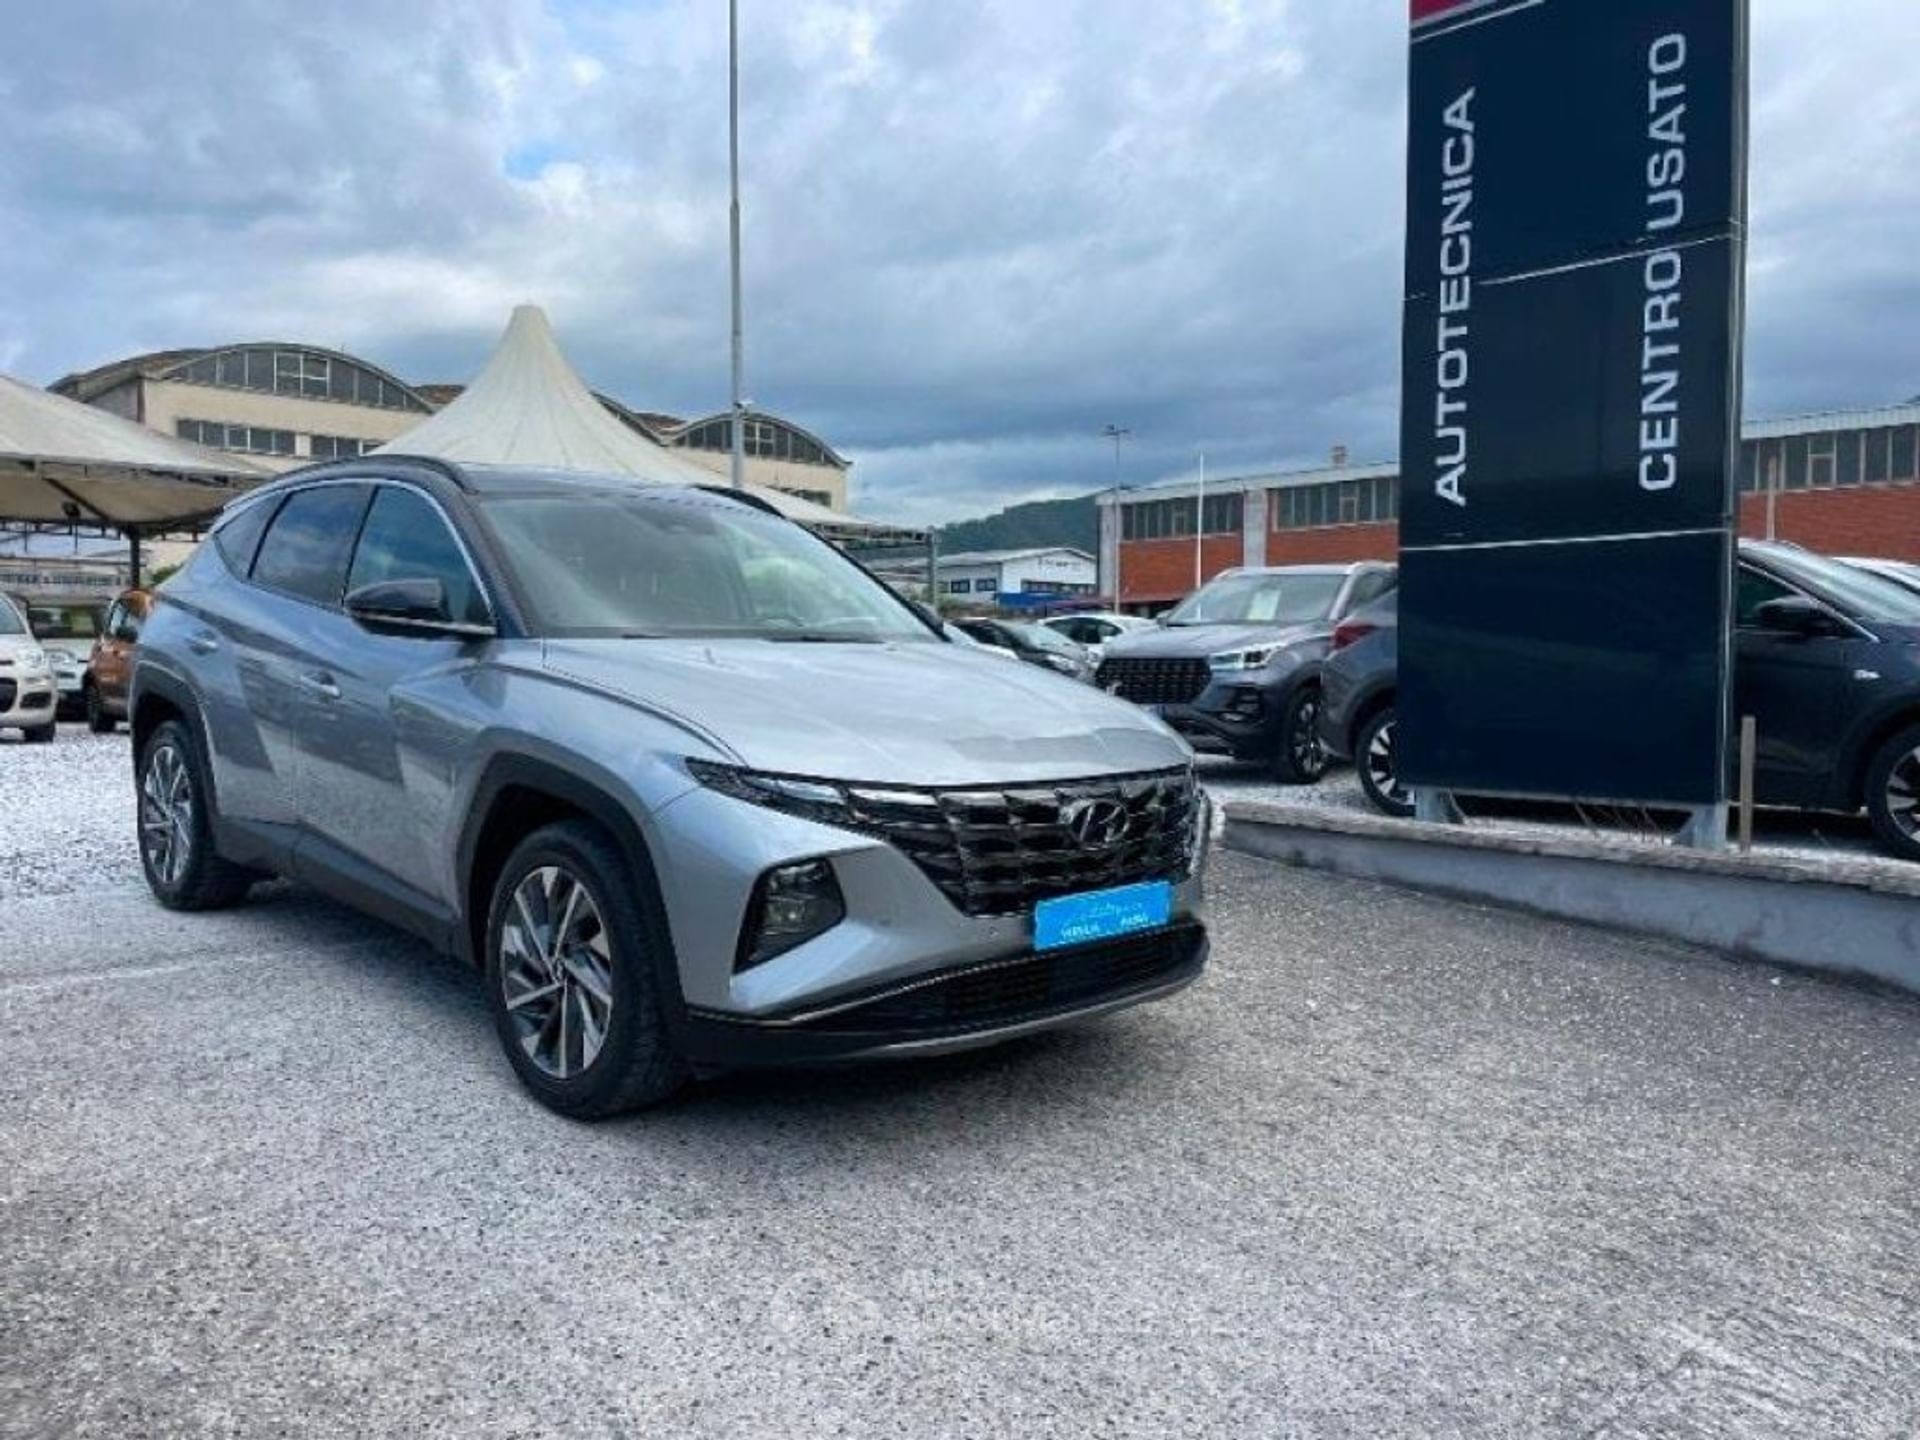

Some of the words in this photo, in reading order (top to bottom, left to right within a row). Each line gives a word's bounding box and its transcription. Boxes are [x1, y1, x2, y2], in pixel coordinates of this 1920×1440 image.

[1647, 32, 1686, 231] USATO
[1435, 87, 1475, 507] AUTOTECNICA
[1639, 250, 1682, 491] CENTRO
